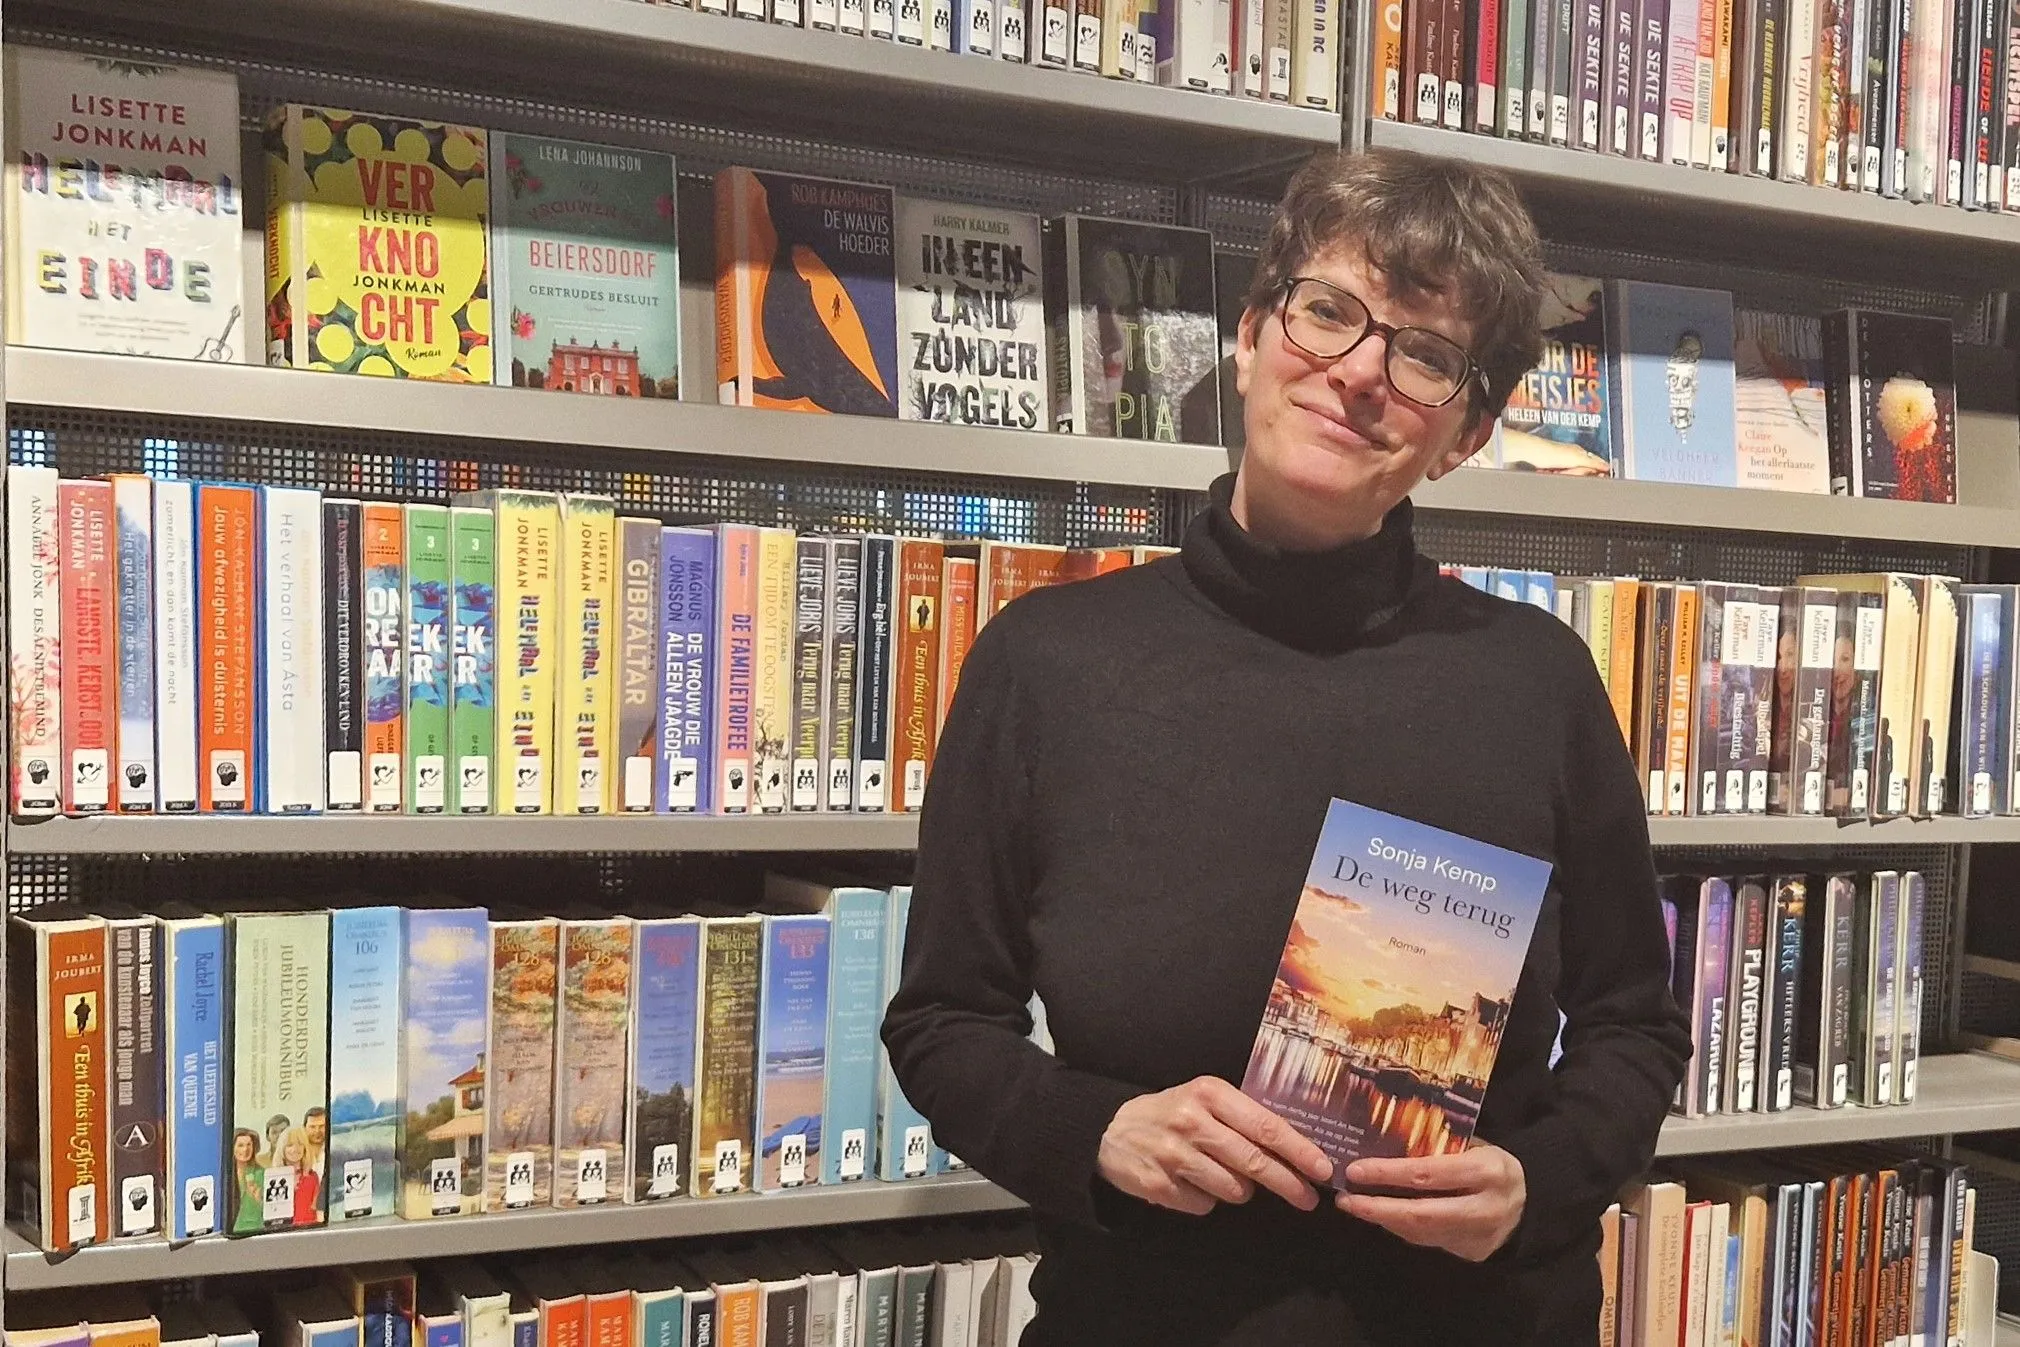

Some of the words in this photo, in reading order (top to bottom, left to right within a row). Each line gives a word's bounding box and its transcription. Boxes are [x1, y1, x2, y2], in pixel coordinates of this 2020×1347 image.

[1587, 4, 1601, 31] DE
[1619, 11, 1631, 37] DE
[1647, 19, 1661, 44] DE
[1585, 34, 1600, 91] SEKTE
[1617, 42, 1630, 99] SEKTE
[1645, 49, 1660, 105] SEKTE
[1980, 48, 1993, 112] LIEFDE
[71, 94, 186, 125] LISETTE
[1670, 98, 1694, 122] OP
[1792, 55, 1811, 134] Vrijheid
[1870, 80, 1881, 143] Avondmensen
[53, 122, 207, 157] JONKMAN
[1981, 117, 1989, 133] OF
[539, 145, 569, 162] LENA
[573, 151, 642, 172] JOHANNSON
[22, 150, 238, 215] HELEMAAL
[358, 158, 434, 212] VER
[88, 220, 131, 241] HET
[362, 208, 432, 227] LISETTE
[824, 209, 840, 229] DE
[843, 213, 889, 234] WALVIS
[933, 215, 966, 231] HARRY
[968, 218, 1009, 236] KALMER
[359, 225, 439, 278] KNO
[530, 240, 657, 277] BEIERSDORF
[839, 233, 889, 256] HOEDER
[922, 234, 958, 276] IN
[962, 239, 1024, 283] EEN
[37, 248, 212, 303] EINDE
[353, 275, 445, 294] JONKMAN
[529, 285, 604, 301] GERTRUDES
[609, 293, 659, 307] BESLUIT
[931, 284, 1016, 332] LAND
[361, 292, 439, 344] CHT
[405, 348, 441, 359] Roman
[911, 329, 1038, 381] ZONDER
[1122, 323, 1165, 373] TO
[1571, 344, 1600, 378] DE
[916, 380, 1038, 429] VOGELS
[1507, 373, 1601, 413] MEISJES
[1115, 392, 1177, 443] PIA
[1508, 407, 1540, 424] HELEEN
[1542, 410, 1559, 425] VAN
[1560, 412, 1577, 426] DER
[1578, 413, 1601, 428] KEMP
[1738, 444, 1771, 455] Keegan
[1774, 445, 1788, 457] Op
[1751, 457, 1765, 467] het
[1767, 459, 1815, 470] allerlaatste
[1747, 471, 1784, 481] moment
[31, 496, 42, 560] ANNABEL
[70, 500, 85, 569] JONKMAN
[90, 510, 104, 561] LISETTE
[214, 505, 229, 544] Jouw
[280, 514, 294, 544] Het
[379, 528, 389, 540] 2
[427, 536, 435, 548] 3
[124, 532, 135, 553] Het
[472, 538, 480, 551] 3
[517, 517, 529, 588] JONKMAN
[536, 527, 548, 580] LISETTE
[581, 520, 593, 592] JONKMAN
[597, 531, 608, 583] LISETTE
[766, 543, 778, 570] EEN
[30, 564, 43, 599] JONK
[122, 558, 136, 616] geknetter
[280, 552, 294, 622] verhaal
[667, 555, 685, 622] JONSSON
[687, 560, 703, 621] MAGNUS
[764, 576, 778, 603] TIJD
[780, 561, 791, 612] Hillary
[799, 556, 821, 591] LIEVE
[836, 558, 857, 592] LIEVE
[211, 549, 229, 640] afwezigheid
[871, 602, 887, 619] Erg
[731, 613, 752, 633] DE
[764, 606, 777, 629] OM
[799, 595, 821, 632] JORIS
[836, 596, 856, 634] JORIS
[1741, 615, 1751, 641] Faye
[126, 636, 136, 650] de
[168, 617, 177, 648] komt
[282, 629, 293, 662] van
[624, 558, 649, 705] GIBRALTAR
[686, 632, 703, 654] DE
[779, 619, 789, 663] Jordan
[1731, 606, 1743, 660] Kellerman
[1756, 609, 1767, 662] Kellerman
[1811, 610, 1822, 662] Kellerman
[214, 644, 228, 656] is
[665, 631, 682, 692] ALLEEN
[797, 639, 821, 678] Terug
[834, 640, 855, 679] Terug
[913, 640, 930, 670] Een
[168, 670, 177, 705] nacht
[213, 661, 228, 735] duisternis
[282, 668, 298, 711] Ásta
[685, 658, 702, 716] VROUW
[727, 638, 751, 751] FAMILIETROFEE
[800, 683, 818, 712] naar
[836, 683, 853, 712] naar
[913, 672, 931, 703] thuis
[1674, 674, 1688, 702] UIT
[1980, 677, 1989, 719] SCHADUW
[663, 697, 682, 760] JAAGDE
[913, 705, 929, 719] in
[1672, 709, 1687, 731] DE
[1730, 692, 1745, 759] Beestachtig
[685, 720, 701, 746] DIE
[1367, 836, 1426, 871] Sonja
[1433, 858, 1498, 892] Kemp
[1331, 854, 1374, 888] De
[1382, 876, 1436, 916] weg
[1443, 891, 1516, 939] terug
[117, 928, 133, 949] van
[138, 927, 153, 963] James
[355, 940, 378, 956] 106
[1388, 936, 1426, 956] Roman
[1780, 917, 1797, 974] KERR
[1835, 915, 1850, 969] KERR
[54, 965, 102, 982] JOUBERT
[64, 951, 94, 965] IRMA
[118, 950, 133, 966] de
[194, 951, 215, 990] Rachel
[723, 950, 748, 964] 131
[117, 966, 134, 1028] kunstenaar
[137, 964, 152, 995] Joyce
[192, 991, 213, 1021] Joyce
[279, 945, 293, 1100] JUBILEUMOMNIBUS
[295, 966, 308, 1078] HONDERDSTE
[1783, 980, 1795, 1034] HITLERS
[118, 1029, 134, 1047] als
[139, 995, 153, 1054] Zelfportret
[73, 1044, 93, 1081] Een
[116, 1047, 134, 1080] jonge
[183, 1053, 198, 1073] VAN
[203, 1040, 217, 1061] HET
[73, 1083, 95, 1119] thuis
[118, 1081, 133, 1106] man
[182, 1074, 198, 1119] QUEENIE
[202, 1064, 216, 1125] LIEFDESLIED
[75, 1121, 92, 1137] in
[122, 1125, 149, 1148] A
[1836, 1233, 1844, 1260] Keuls
[732, 1297, 752, 1322] ROB
